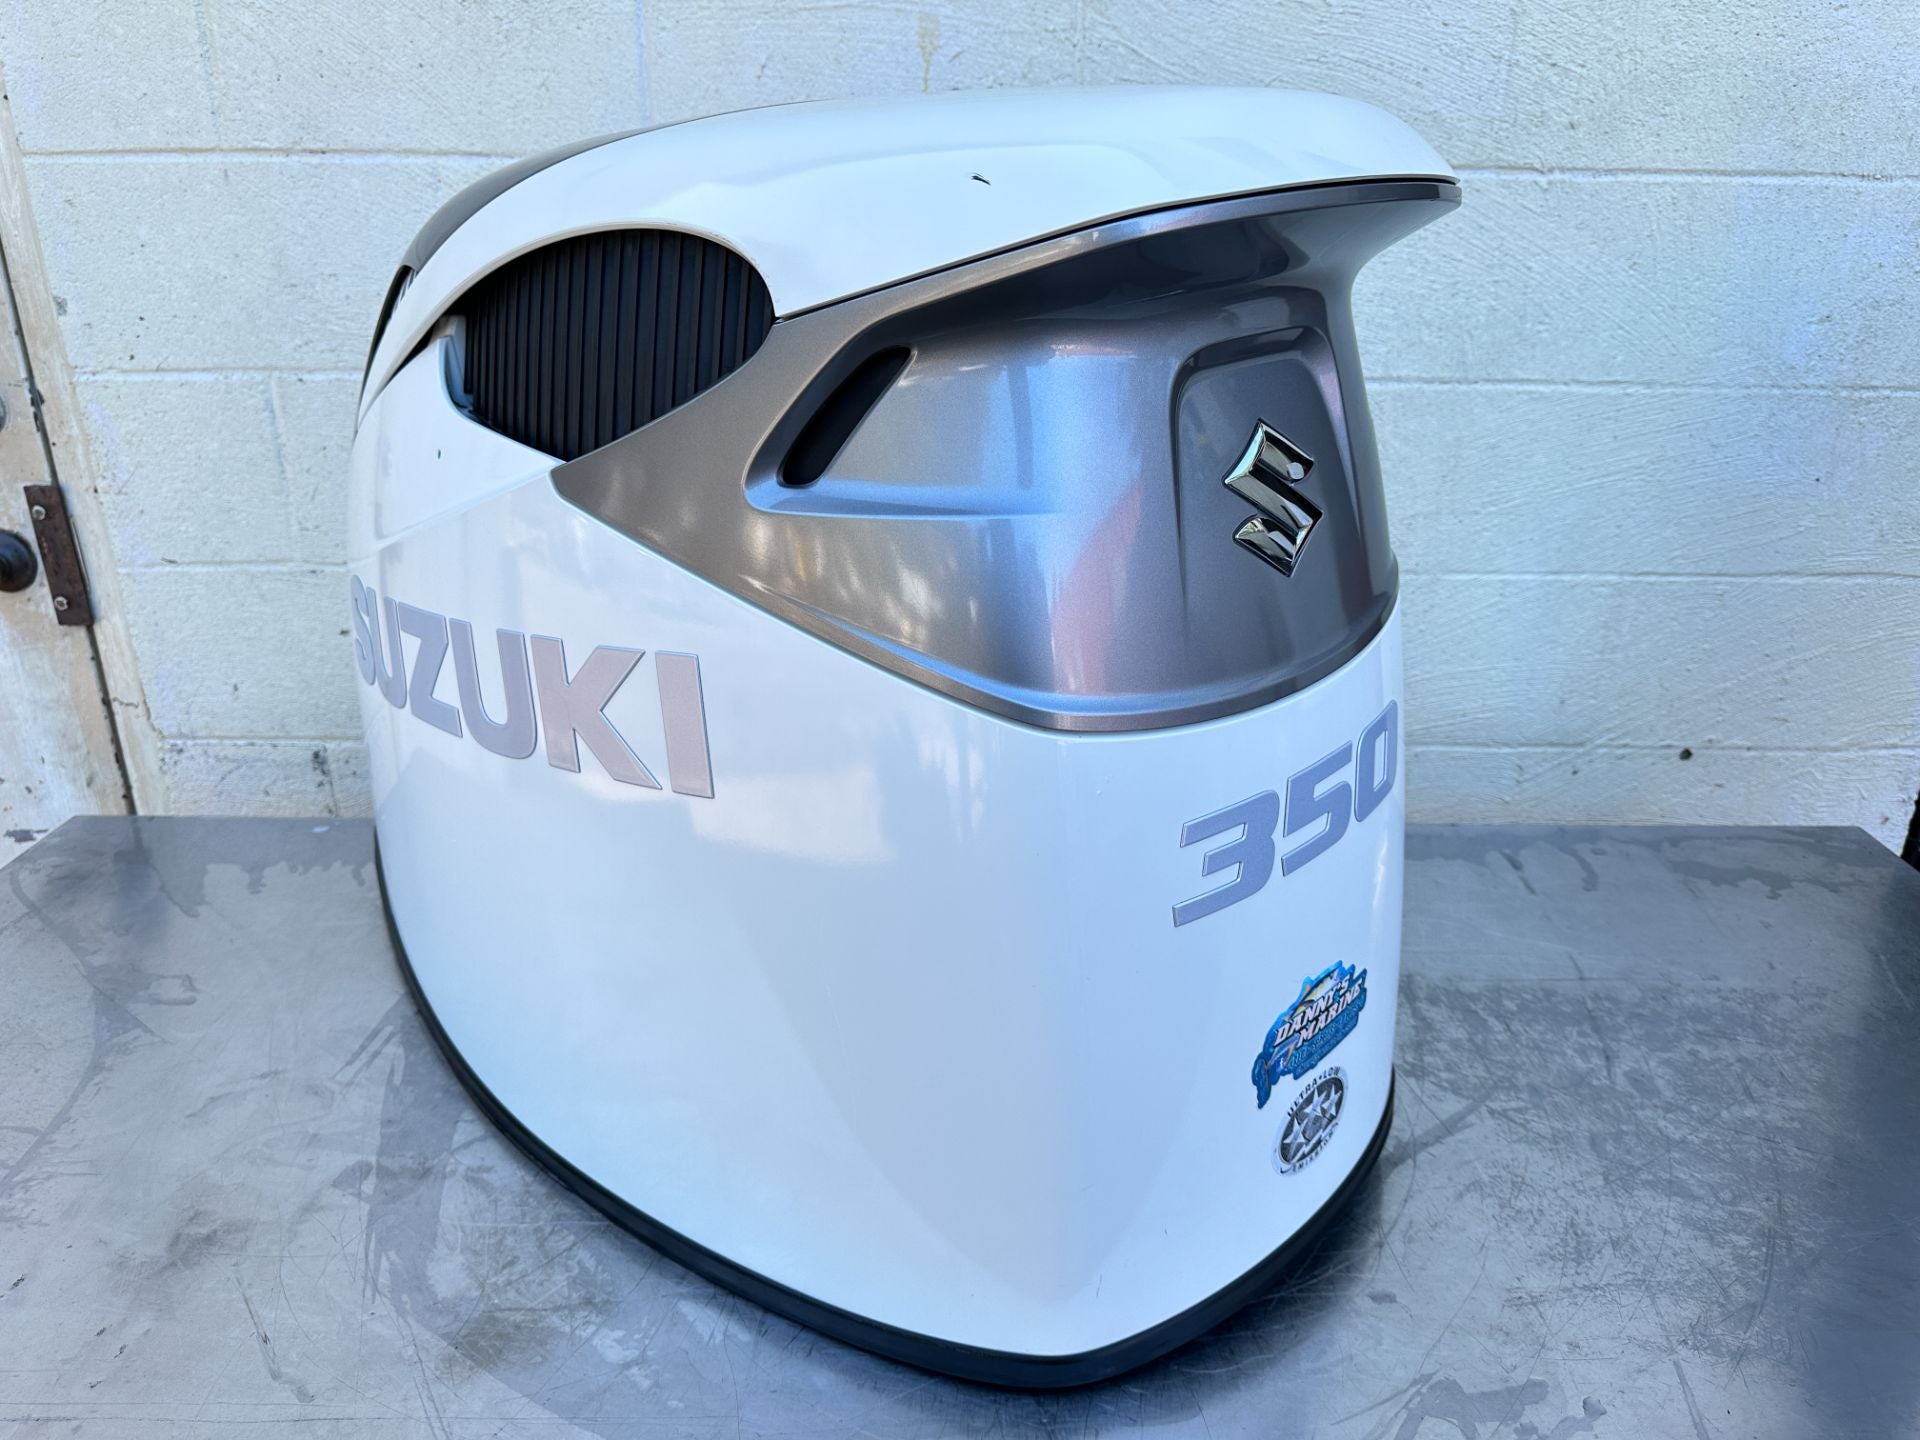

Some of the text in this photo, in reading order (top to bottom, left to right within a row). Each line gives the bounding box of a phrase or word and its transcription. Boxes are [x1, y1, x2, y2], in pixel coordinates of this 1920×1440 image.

[350, 574, 714, 799] SUZUKI
[1172, 699, 1398, 928] 350
[1274, 974, 1350, 1048] DANNY'S
[1296, 977, 1363, 1048] MARINE
